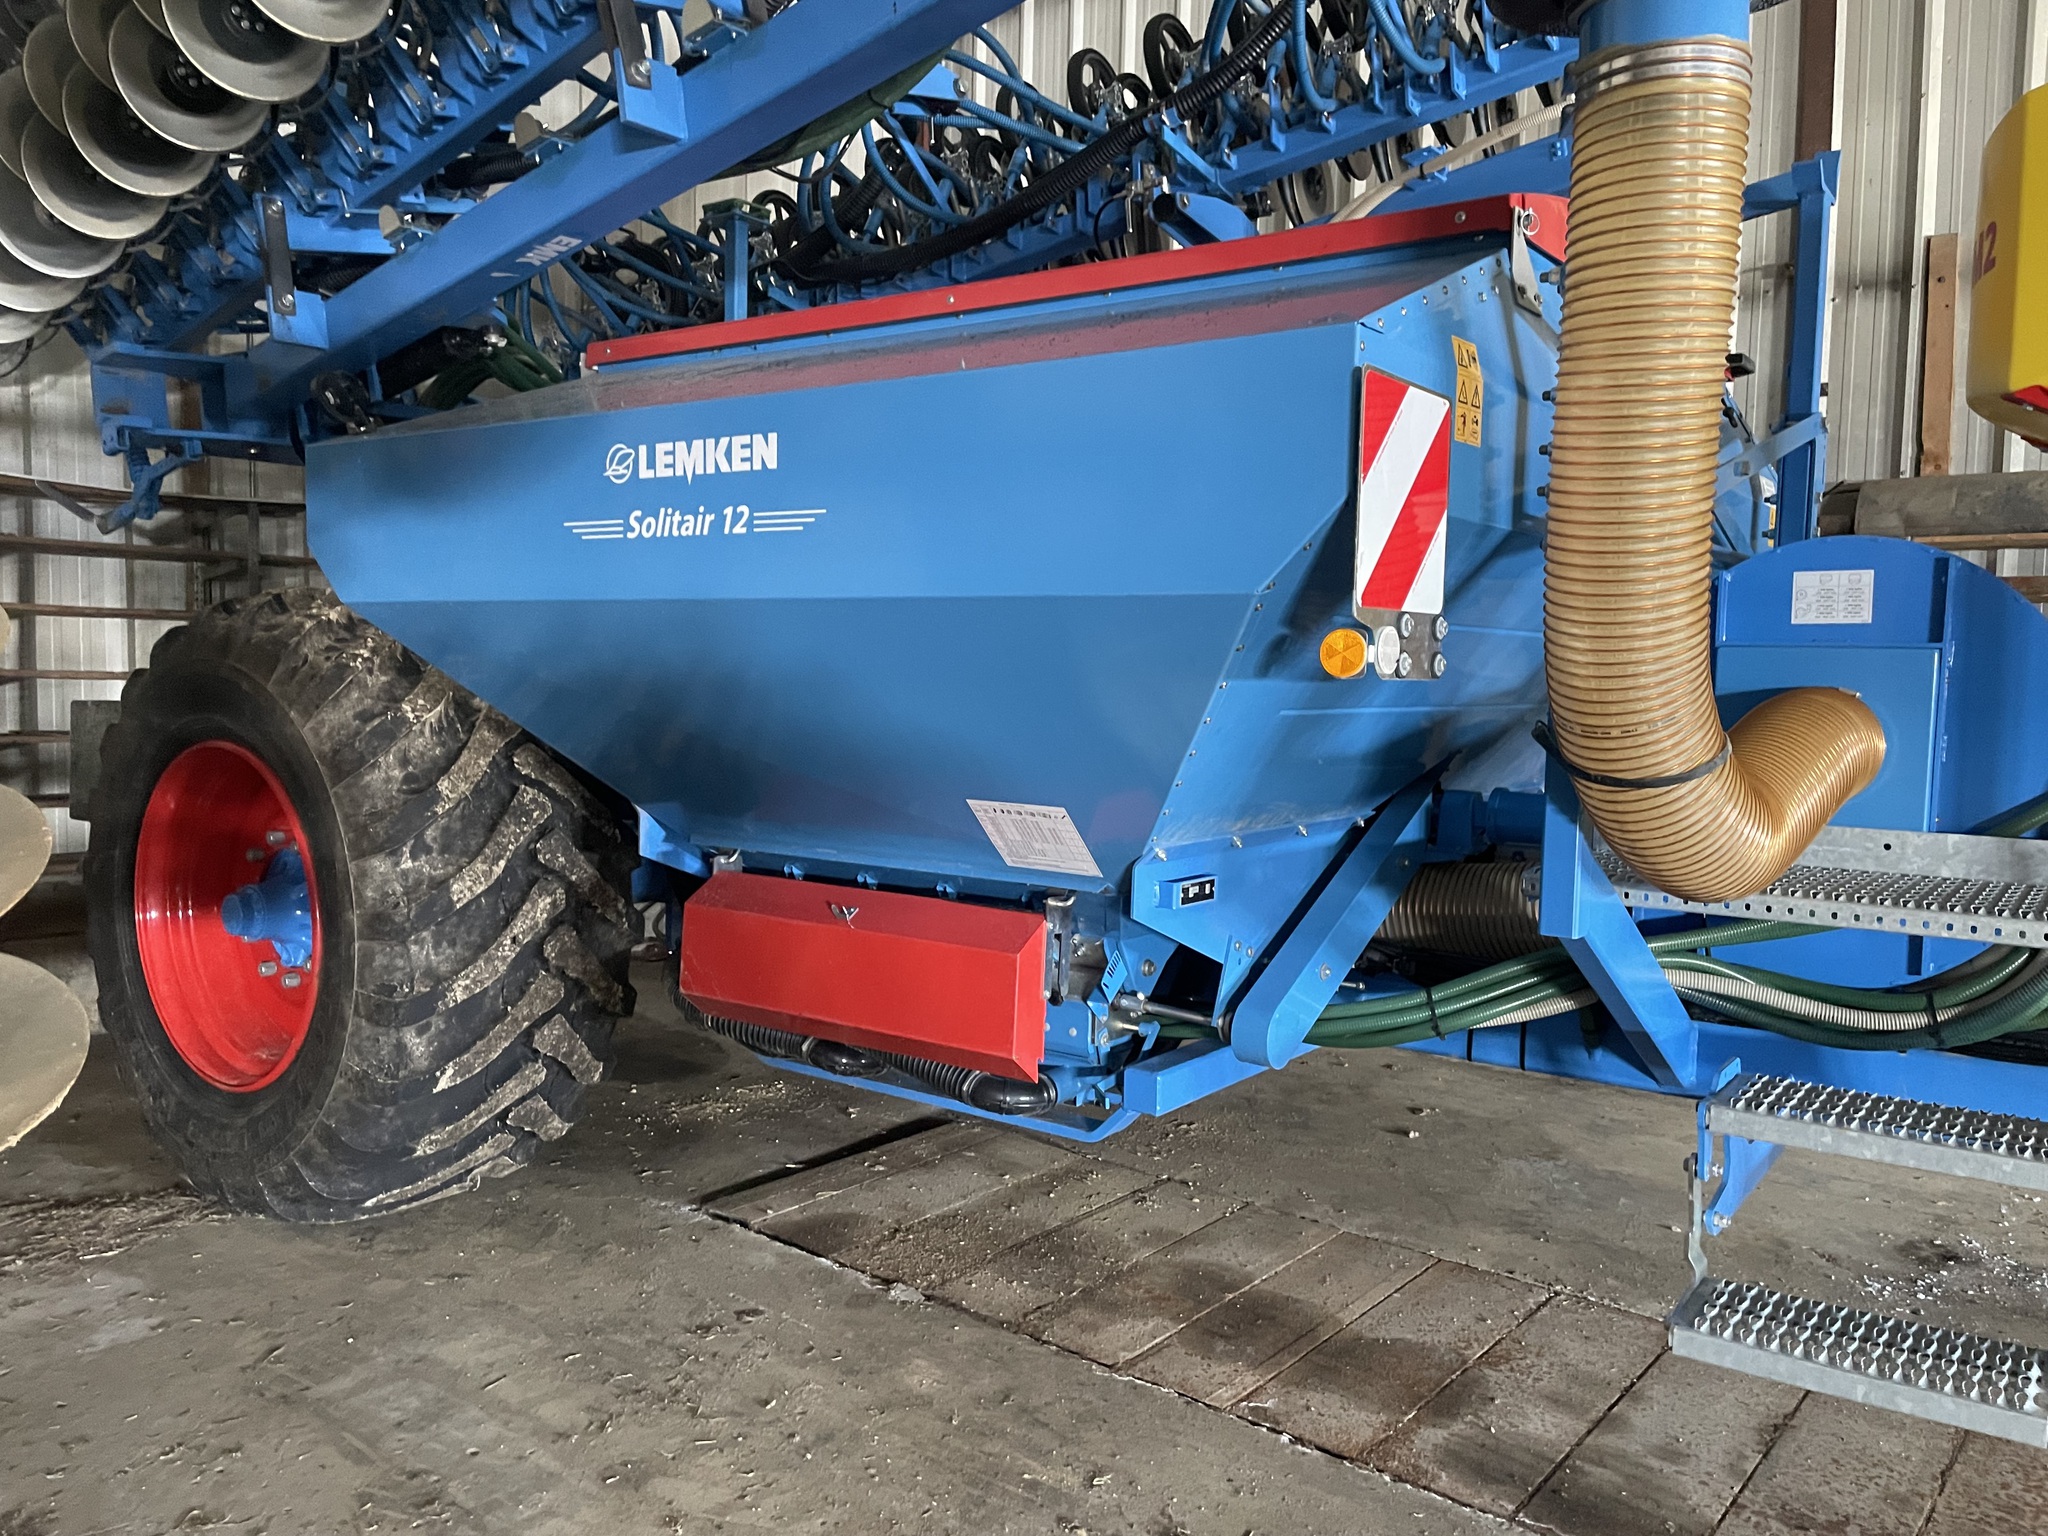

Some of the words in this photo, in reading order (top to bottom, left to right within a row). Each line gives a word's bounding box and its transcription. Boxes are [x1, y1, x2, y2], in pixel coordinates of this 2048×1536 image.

[638, 432, 778, 485] LEMKEN
[626, 506, 715, 539] Solitair
[722, 505, 750, 534] 12
